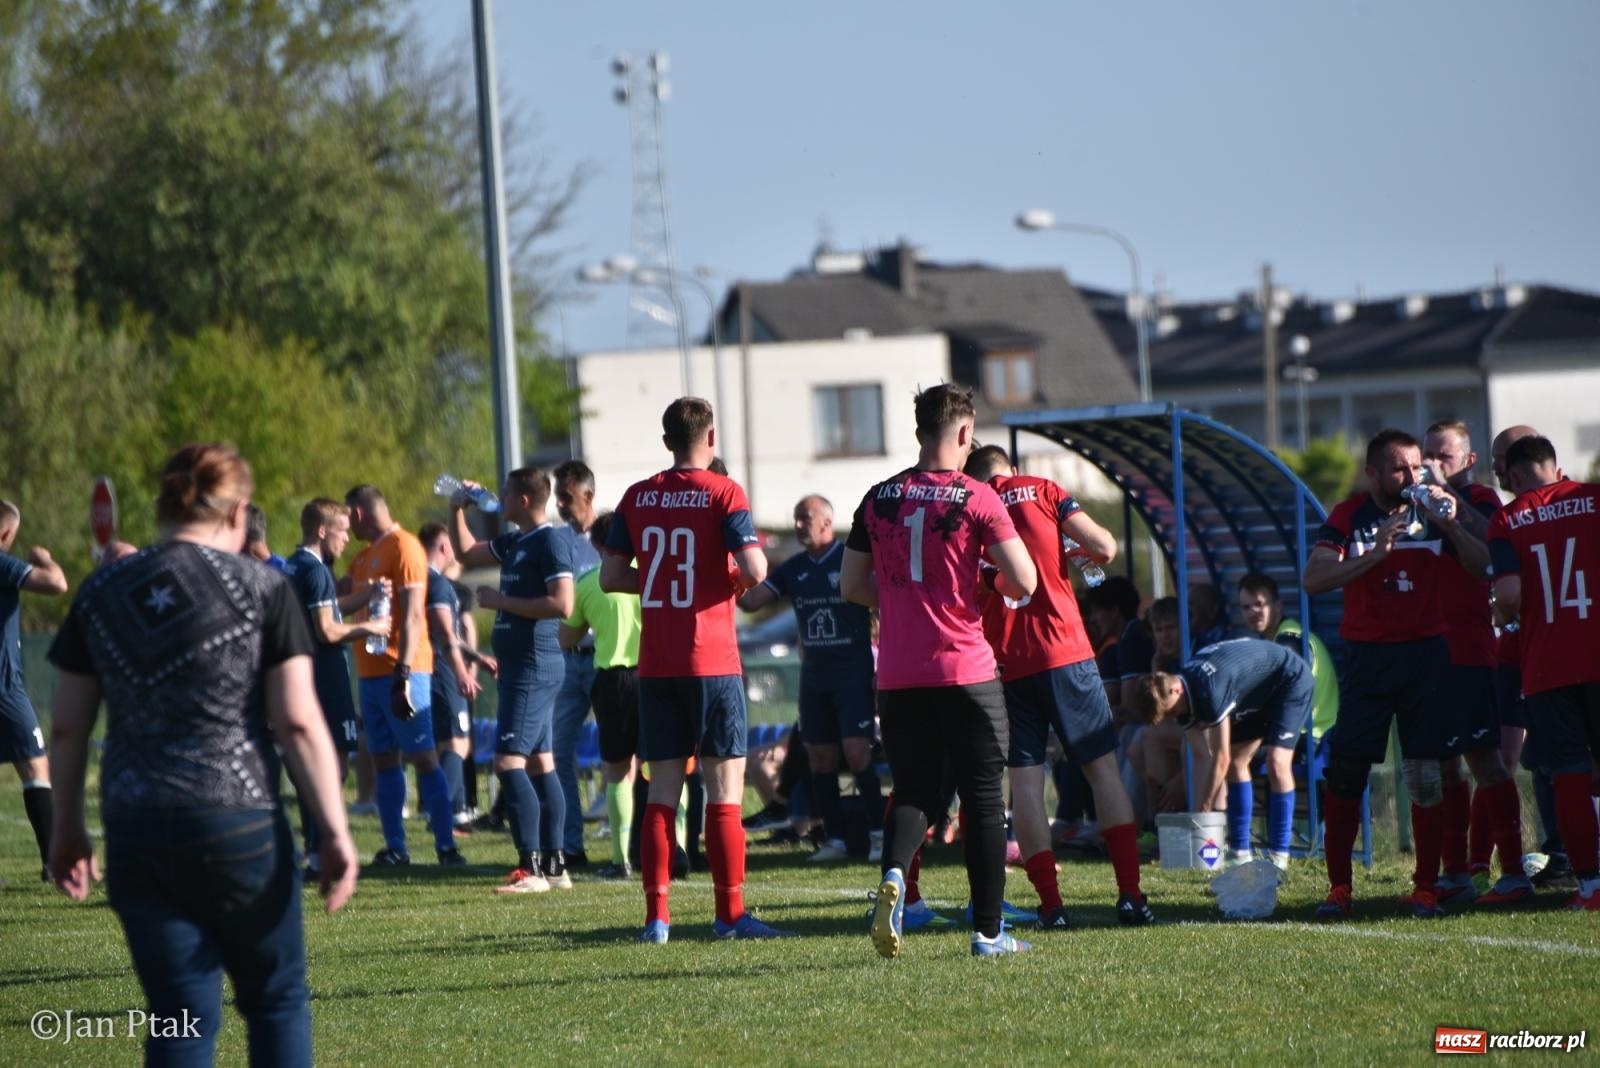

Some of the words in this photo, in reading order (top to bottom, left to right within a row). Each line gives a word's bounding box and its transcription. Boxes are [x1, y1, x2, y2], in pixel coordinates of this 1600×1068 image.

[636, 490, 658, 507] LKS
[661, 490, 711, 508] BRZEZIE
[877, 483, 903, 500] LKS
[906, 485, 967, 503] BRZEZIE
[1000, 485, 1038, 507] ZEZIE
[1508, 508, 1535, 530] LKS
[1537, 496, 1596, 522] BRZEZIE
[903, 507, 925, 583] 1
[641, 526, 695, 608] 23
[1530, 537, 1592, 624] 14
[342, 719, 358, 741] 14
